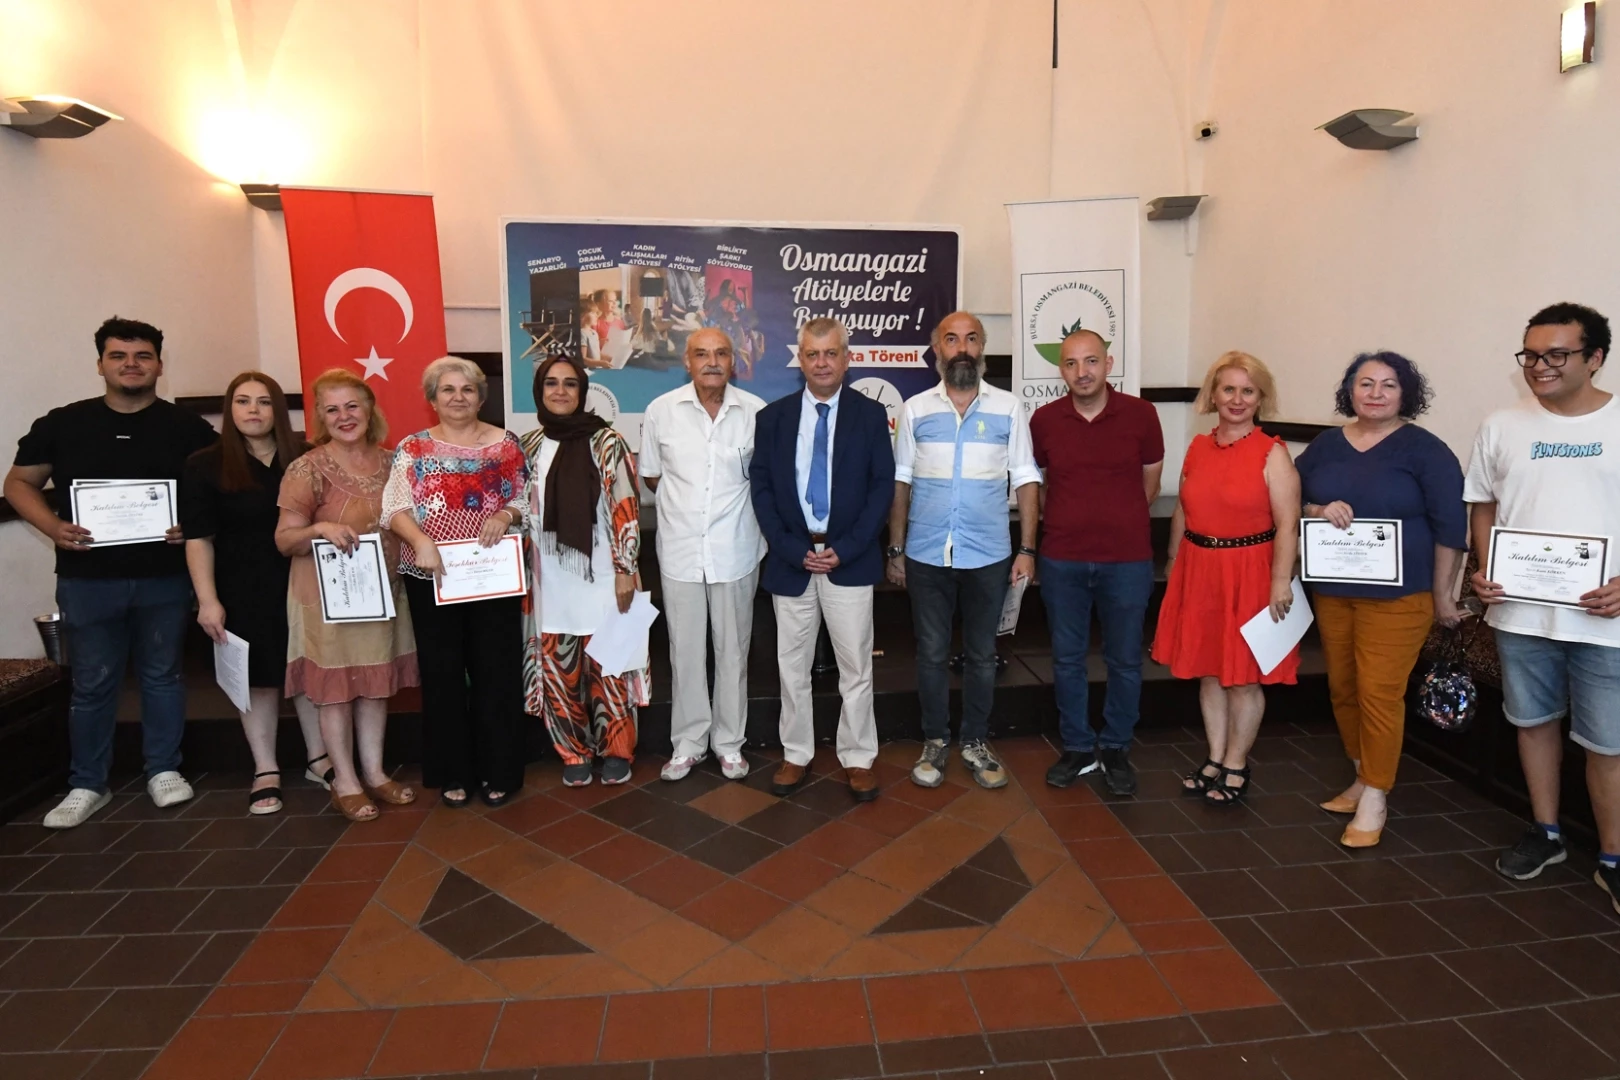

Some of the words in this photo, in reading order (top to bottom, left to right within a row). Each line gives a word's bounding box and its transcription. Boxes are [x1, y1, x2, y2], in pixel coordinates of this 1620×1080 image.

[577, 246, 603, 256] ÇOCUK
[620, 250, 668, 260] ÇALIŞMALARI
[716, 244, 748, 256] BİRLİKTE
[527, 255, 562, 267] SENARYO
[578, 254, 606, 264] DRAMA
[628, 258, 662, 267] ATÖLYESİ
[674, 255, 695, 264] RİTİM
[719, 253, 741, 262] ŞARKI
[779, 243, 928, 281] Osmangazi
[529, 262, 567, 275] YAZARLIĞI
[580, 259, 614, 271] ATÖLYESİ
[667, 262, 702, 273] ATÖLYESİ
[706, 258, 753, 272] SÖYLÜYORUZ
[791, 277, 913, 309] Atölyelerle
[1033, 280, 1077, 312] OSMANGAZİ
[1078, 281, 1116, 319] BELEDİYESİ
[1030, 313, 1038, 340] BURSA
[868, 350, 919, 362] Töreni
[1530, 441, 1603, 460] FLINTSTONES
[1353, 539, 1385, 549] Belgesi
[1508, 552, 1547, 563] Katılım
[1550, 555, 1588, 569] Belgesi
